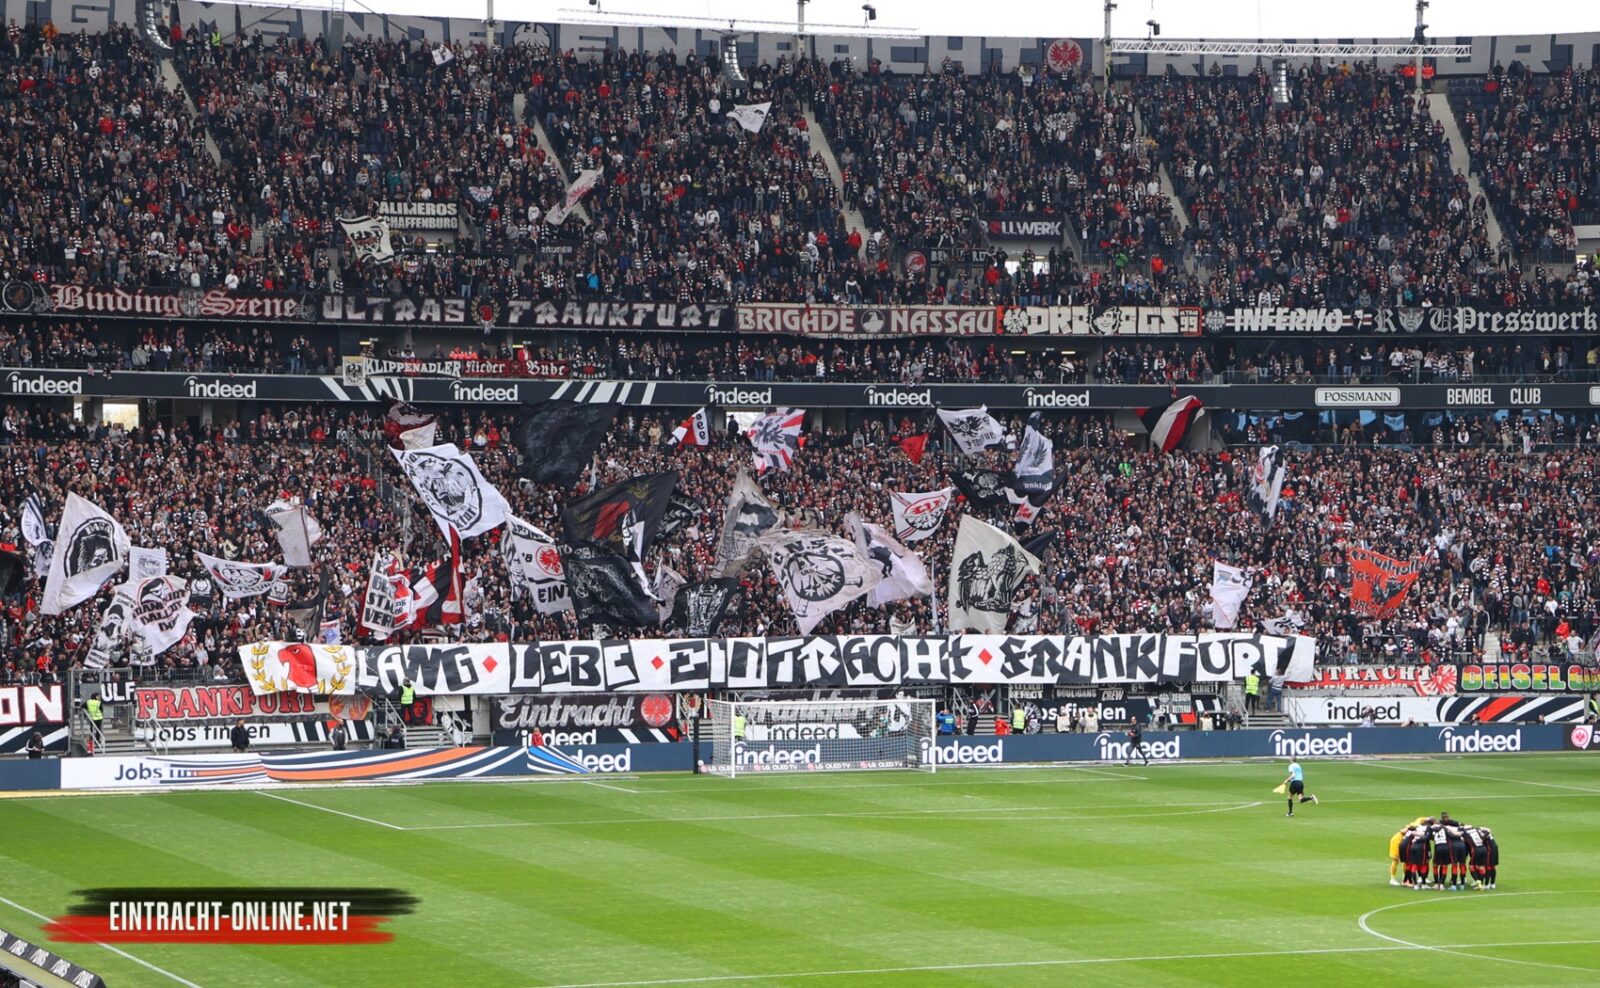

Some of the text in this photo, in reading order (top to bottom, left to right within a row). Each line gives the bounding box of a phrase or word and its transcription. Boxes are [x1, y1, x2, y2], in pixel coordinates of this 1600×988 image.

[384, 215, 459, 230] CHAFFENBURG
[51, 284, 301, 318] Binding Szene
[323, 297, 730, 327] ULTRAS FRANKFURT
[737, 308, 995, 335] BRIGADE NASSAU
[1234, 307, 1344, 333] INFERNO
[1453, 304, 1599, 335] Presswerk
[1179, 316, 1198, 332] 99
[365, 356, 461, 378] KLIPPENADLER
[11, 374, 82, 395] indeed
[188, 379, 257, 399] indeed
[453, 382, 519, 402] indeed
[708, 386, 772, 405] indeed
[868, 387, 931, 407] indeed
[1026, 389, 1090, 408] indeed
[1324, 391, 1392, 402] POSSMANN
[1447, 387, 1542, 405] BEMBEL CLUB
[509, 642, 640, 689] LEBE
[999, 633, 1289, 683] FRANKFURT
[1309, 664, 1432, 682] NTRACHT
[499, 692, 635, 728] Eintracht
[1328, 701, 1400, 721] inded
[204, 724, 271, 741] finen
[521, 728, 597, 747] ideed
[1444, 728, 1521, 752] indeed
[921, 738, 1004, 764] indeed
[1274, 731, 1352, 755] indeed
[572, 748, 632, 772] deed
[736, 743, 821, 764] indeed
[114, 762, 164, 781] Jobs
